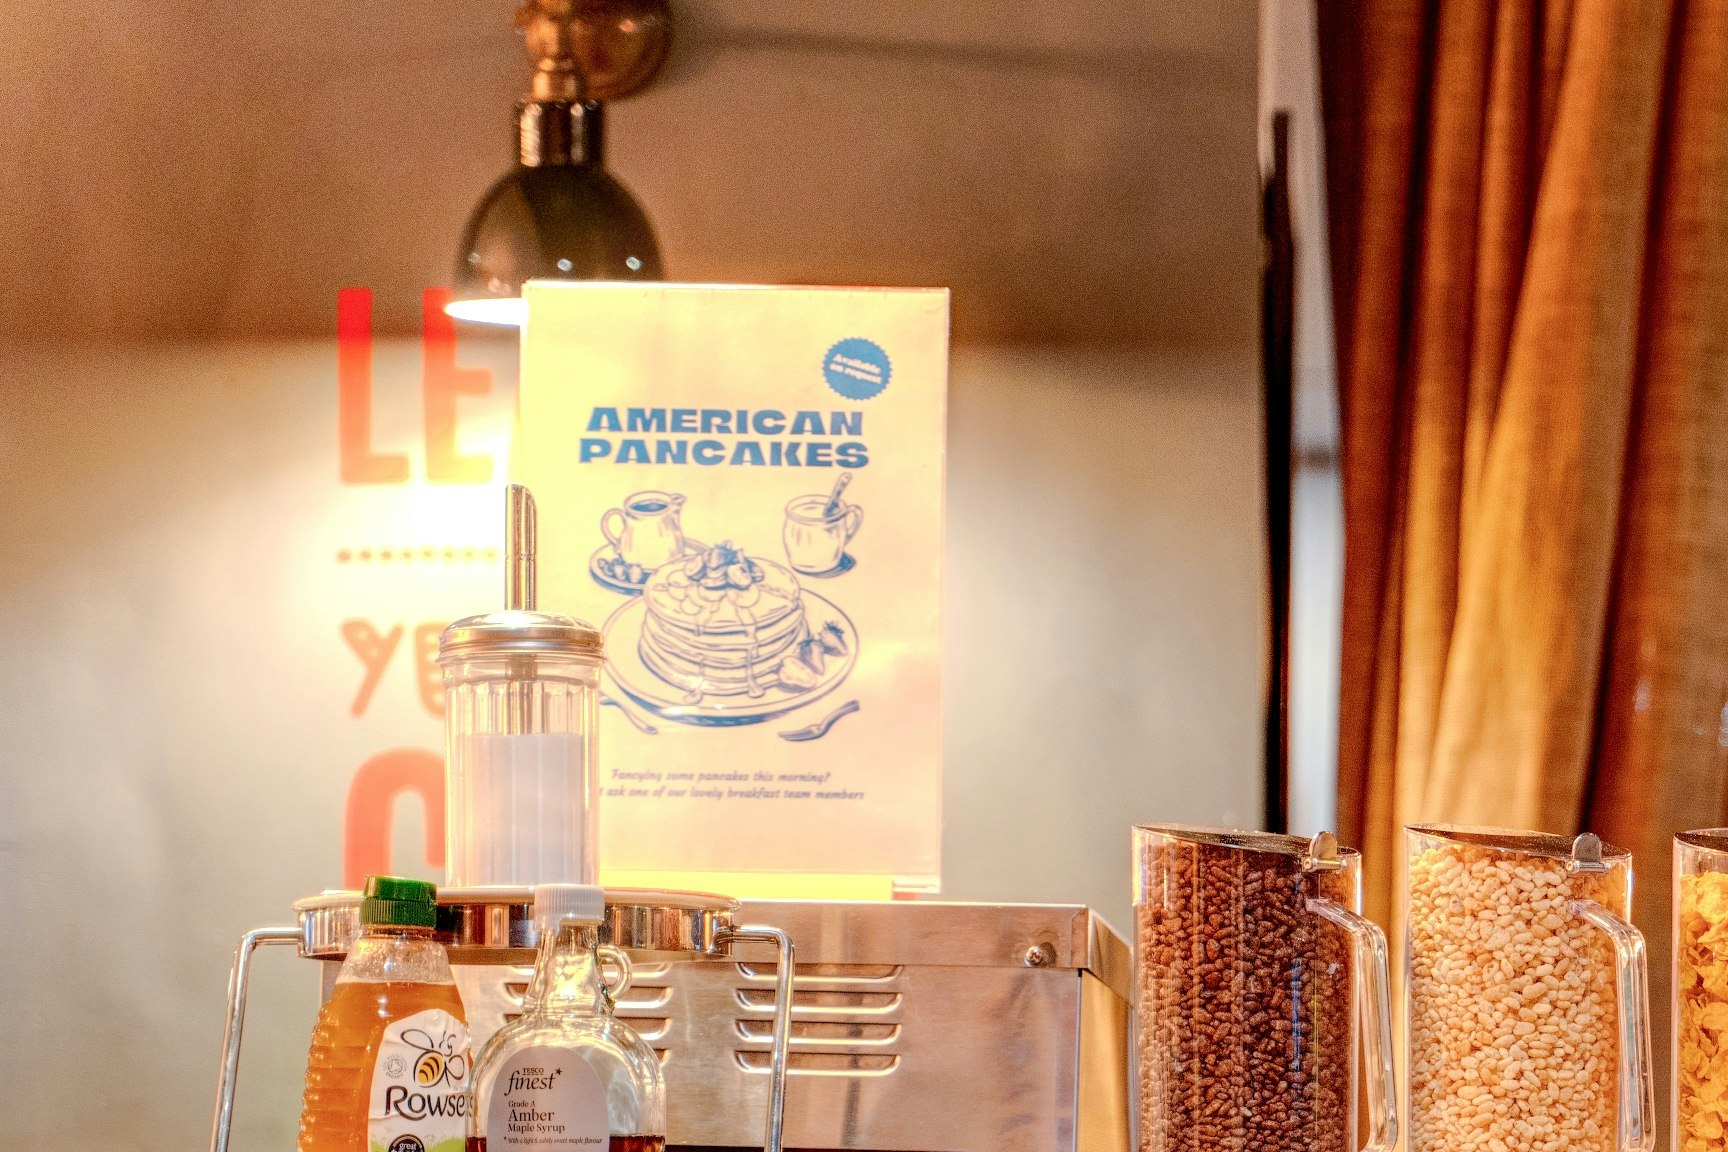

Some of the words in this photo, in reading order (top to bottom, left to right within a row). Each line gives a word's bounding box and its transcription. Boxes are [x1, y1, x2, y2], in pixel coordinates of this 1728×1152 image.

[585, 406, 864, 436] AMERICAN
[578, 438, 870, 469] PANCAKES
[611, 769, 662, 783] Fancying
[666, 772, 694, 781] some
[697, 770, 749, 783] pancakes
[753, 770, 774, 782] this
[776, 771, 831, 784] morning?
[606, 785, 626, 797] ask
[628, 788, 649, 797] one
[652, 785, 667, 799] of
[667, 788, 687, 797] our
[690, 786, 724, 800] lovely
[726, 786, 781, 800] breakfast
[783, 788, 811, 800] team
[814, 787, 865, 800] members
[503, 1070, 557, 1097] finest
[384, 1085, 466, 1122] Rowse
[508, 1100, 529, 1108] Grade
[530, 1100, 536, 1108] A
[508, 1108, 555, 1122] Amber
[507, 1123, 535, 1134] Maple
[536, 1123, 566, 1134] Syrup
[399, 1142, 417, 1152] great
